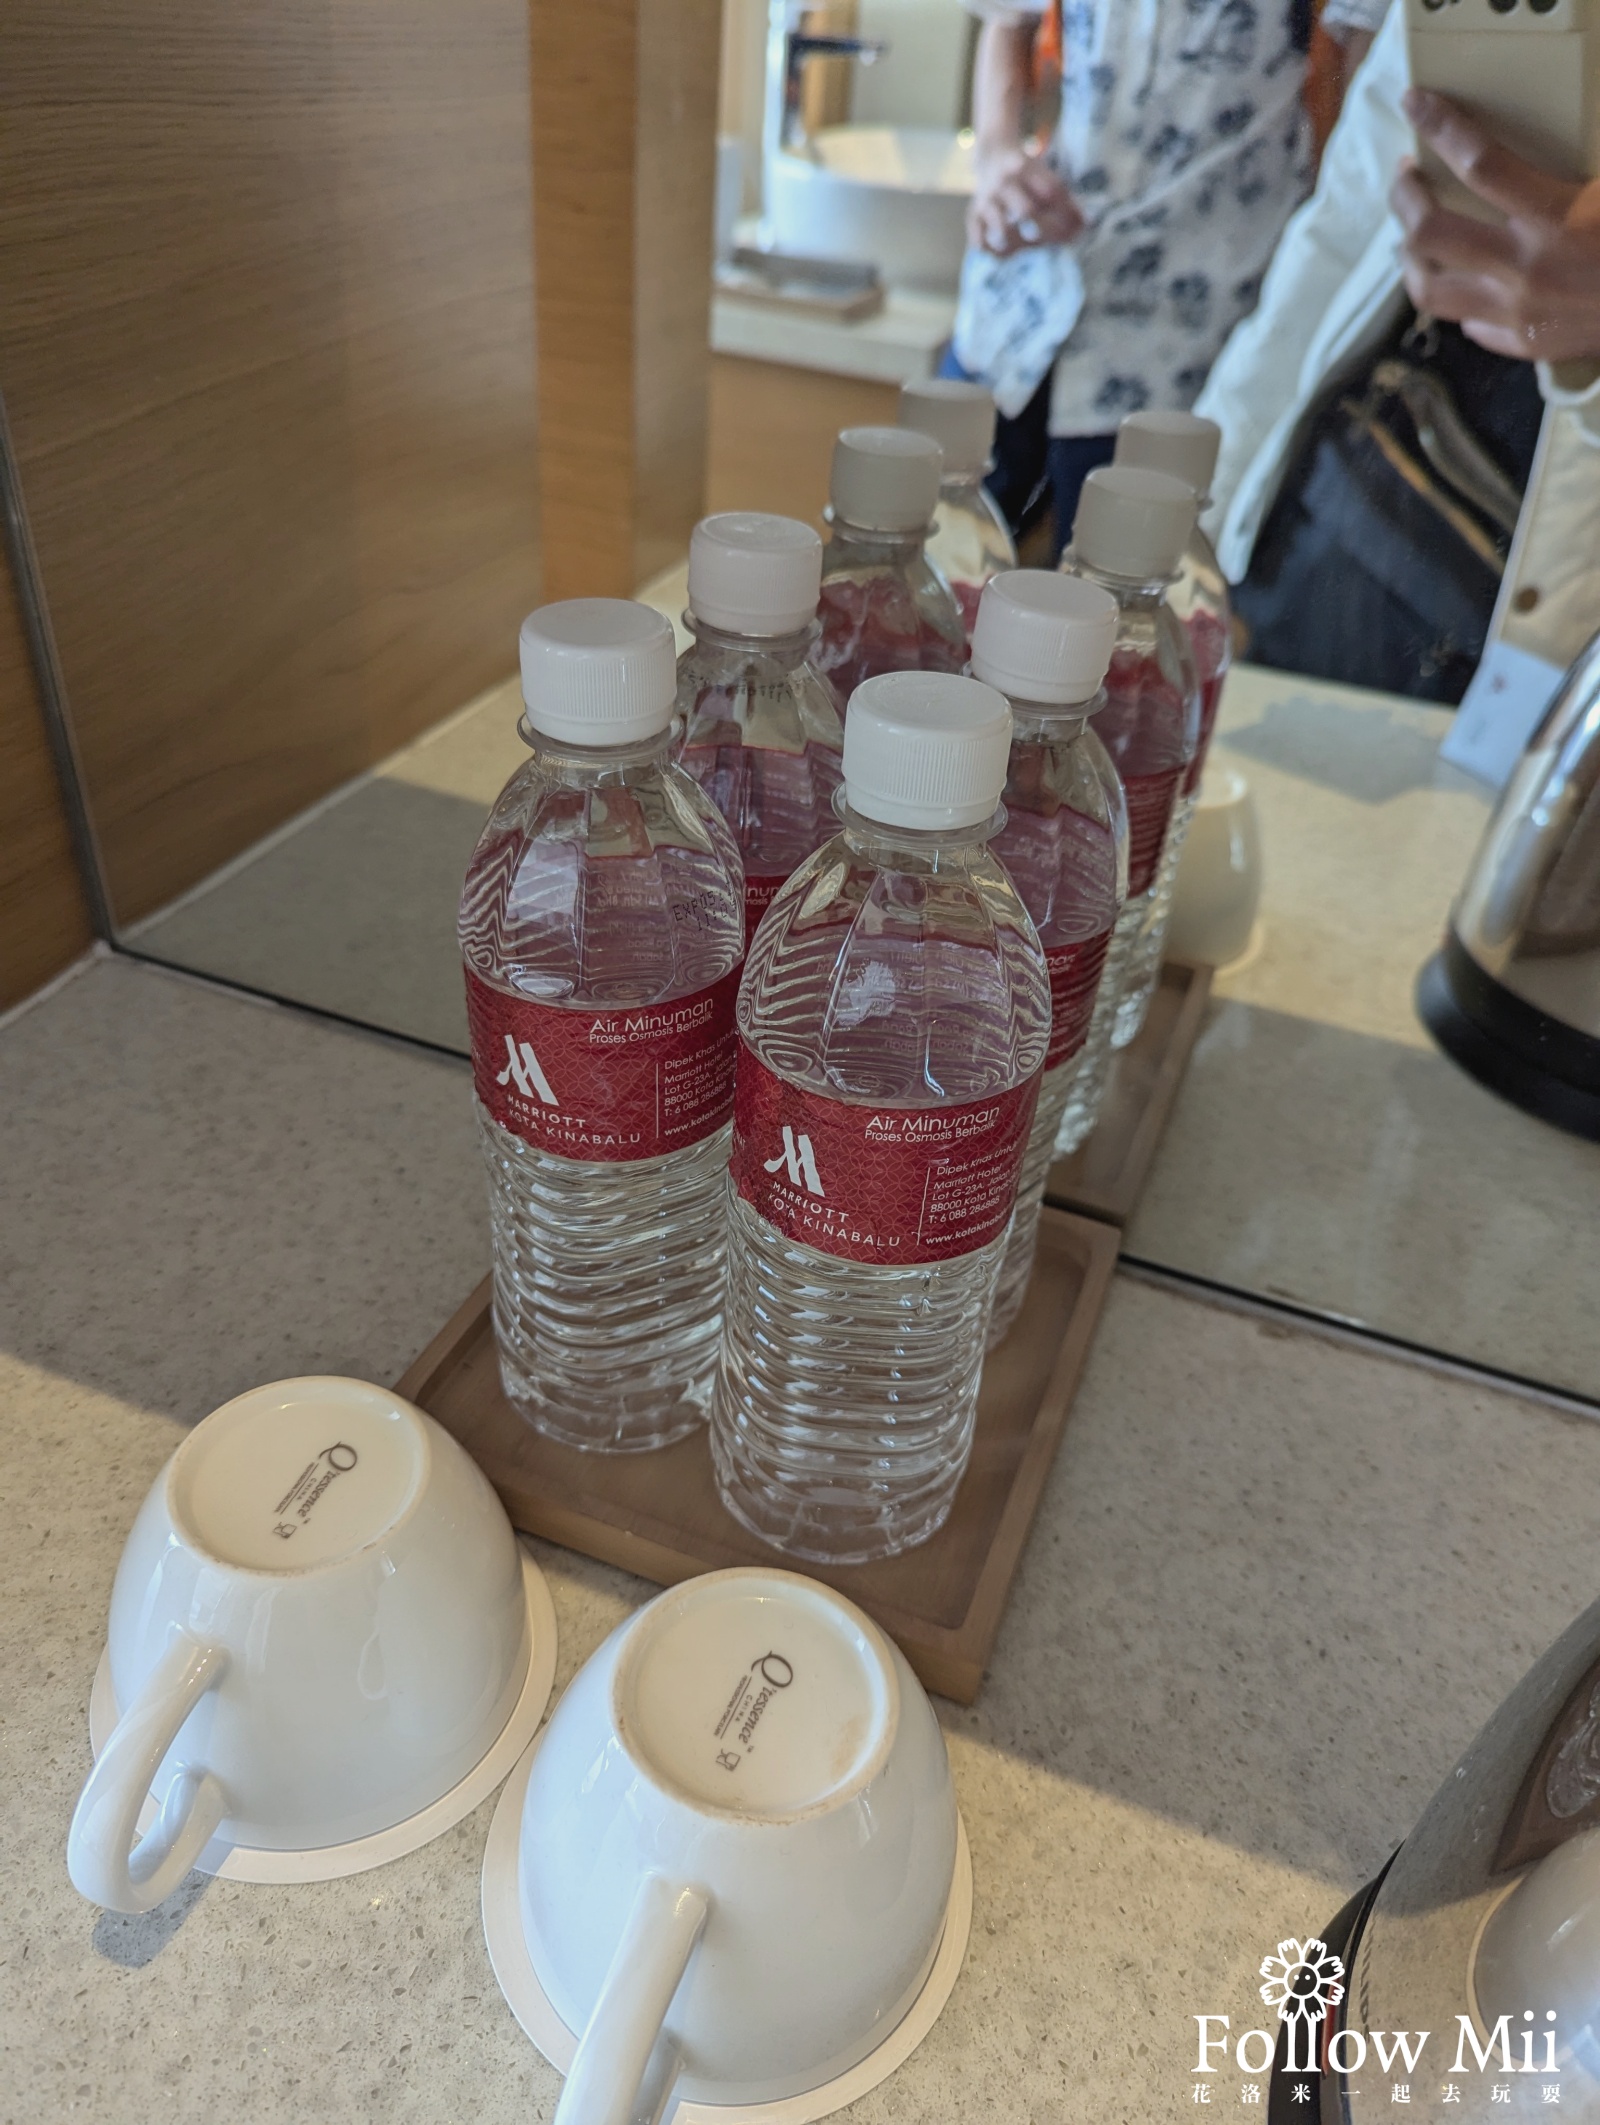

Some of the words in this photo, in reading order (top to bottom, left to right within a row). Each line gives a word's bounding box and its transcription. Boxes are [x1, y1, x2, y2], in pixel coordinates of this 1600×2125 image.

[590, 1018, 619, 1034] Air
[625, 998, 714, 1032] Minuman
[590, 1033, 626, 1044] Proses
[629, 1026, 674, 1042] Osmosis
[676, 1012, 714, 1033] Berbalik
[664, 1054, 694, 1070] Dipek
[695, 1044, 716, 1060] Khas
[664, 1064, 702, 1084] Marriott
[704, 1050, 723, 1070] Hotel
[664, 1084, 681, 1095] Lot
[664, 1090, 694, 1106] 88000
[695, 1080, 714, 1096] Kota
[508, 1095, 586, 1129] MARRIOTT
[664, 1108, 673, 1117] T:
[674, 1106, 681, 1114] 6
[682, 1098, 699, 1111] 088
[866, 1115, 898, 1130] Air
[902, 1106, 1000, 1131] Minuman
[508, 1109, 541, 1131] KOTA
[546, 1127, 641, 1145] KINABALU
[864, 1129, 902, 1142] Proses
[905, 1130, 952, 1143] Osmosis
[955, 1119, 997, 1138] Berbalik
[933, 1173, 975, 1190] Marriott
[977, 1162, 1003, 1180] Hotel
[936, 1162, 969, 1176] Dipek
[772, 1180, 849, 1223] MARRIOTT
[930, 1199, 962, 1213] 88000
[963, 1191, 987, 1205] Kota
[932, 1191, 949, 1201] Lot
[768, 1193, 796, 1220] KOTA
[803, 1217, 900, 1247] KINABALU
[928, 1215, 938, 1224] T:
[940, 1213, 947, 1223] 6
[948, 1208, 967, 1221] 088
[735, 1694, 753, 1722] CHINA
